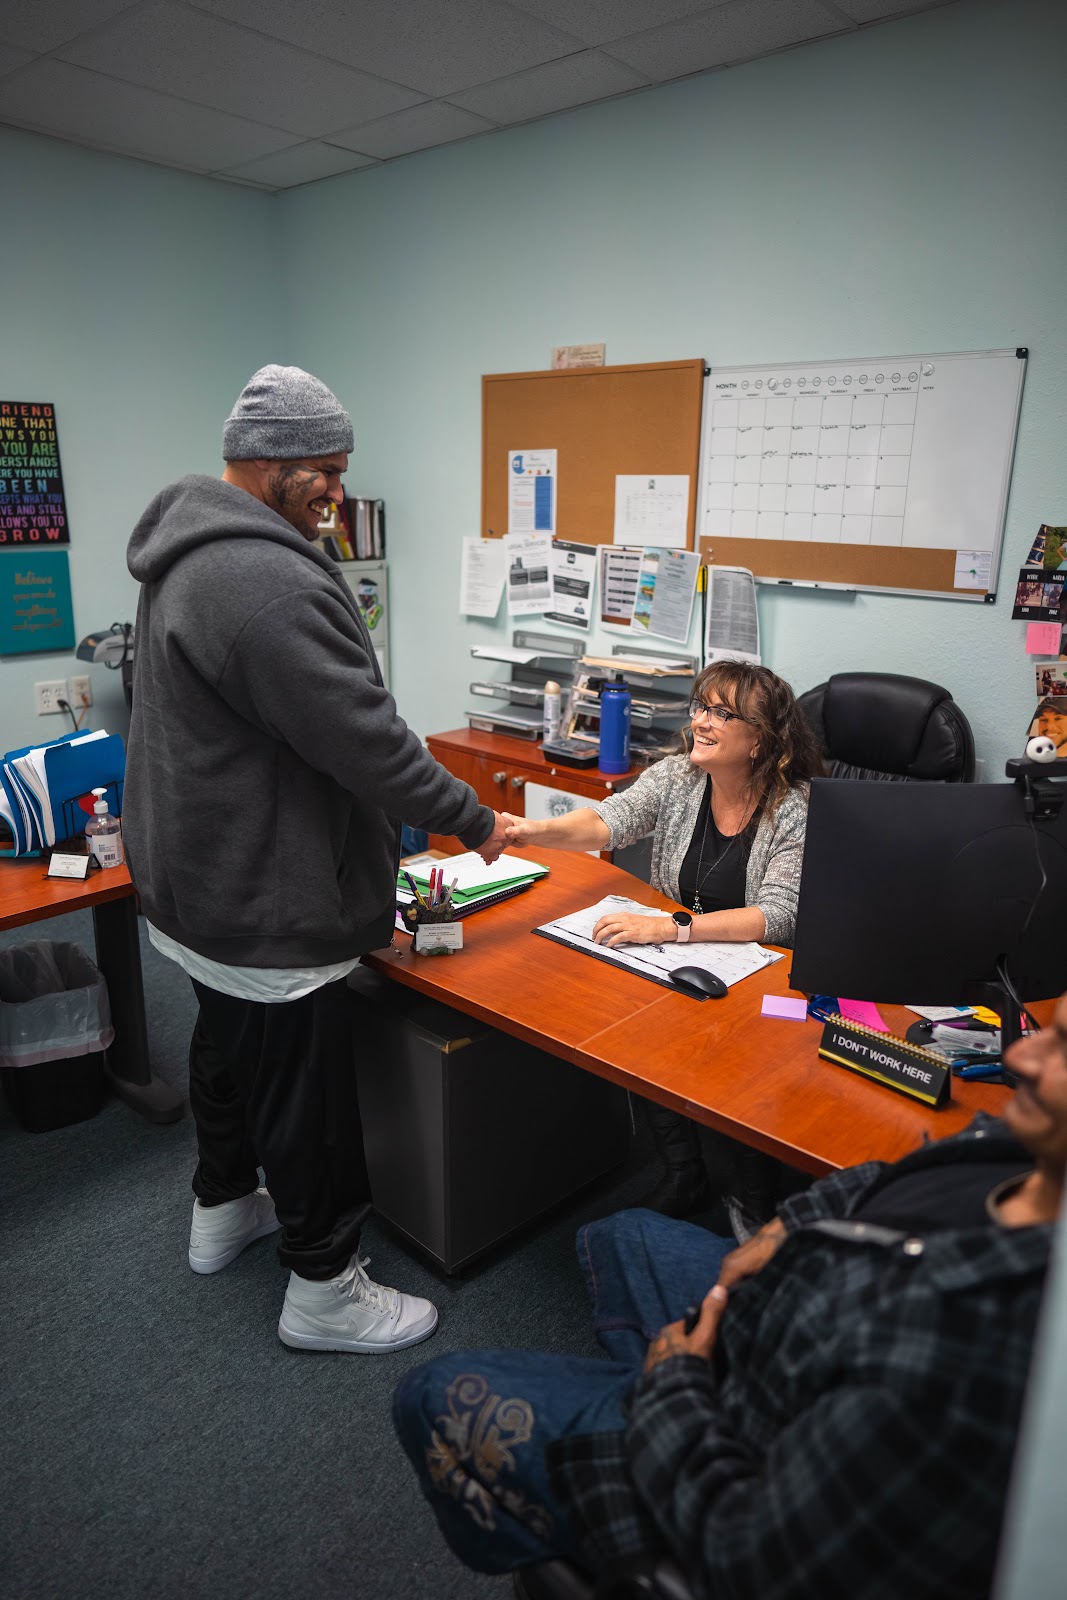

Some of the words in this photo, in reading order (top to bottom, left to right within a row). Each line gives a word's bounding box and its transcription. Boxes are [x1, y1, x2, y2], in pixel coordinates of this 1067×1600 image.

[1, 404, 53, 417] RIEND
[0, 417, 18, 428] NE
[22, 418, 54, 429] THAT
[29, 430, 56, 442] YOU
[1, 442, 28, 456] YOU
[32, 442, 58, 456] ARE
[0, 456, 58, 468] ERSTANDS
[0, 468, 13, 478] RE
[14, 468, 33, 478] YOU
[34, 468, 59, 478] HAVE
[0, 479, 47, 493] BEEN
[0, 494, 20, 504] EPTS
[22, 493, 45, 503] WHAT
[46, 493, 63, 503] YOU
[0, 505, 13, 515] VE
[16, 504, 36, 515] AND
[38, 504, 64, 514] STILL
[0, 516, 28, 528] LOWS
[31, 516, 50, 528] YOU
[52, 515, 65, 527] TO
[0, 528, 60, 542] GROW
[832, 1034, 837, 1043] I
[838, 1037, 868, 1055] DON'T
[870, 1050, 901, 1070] WORK
[902, 1064, 932, 1084] HERE
